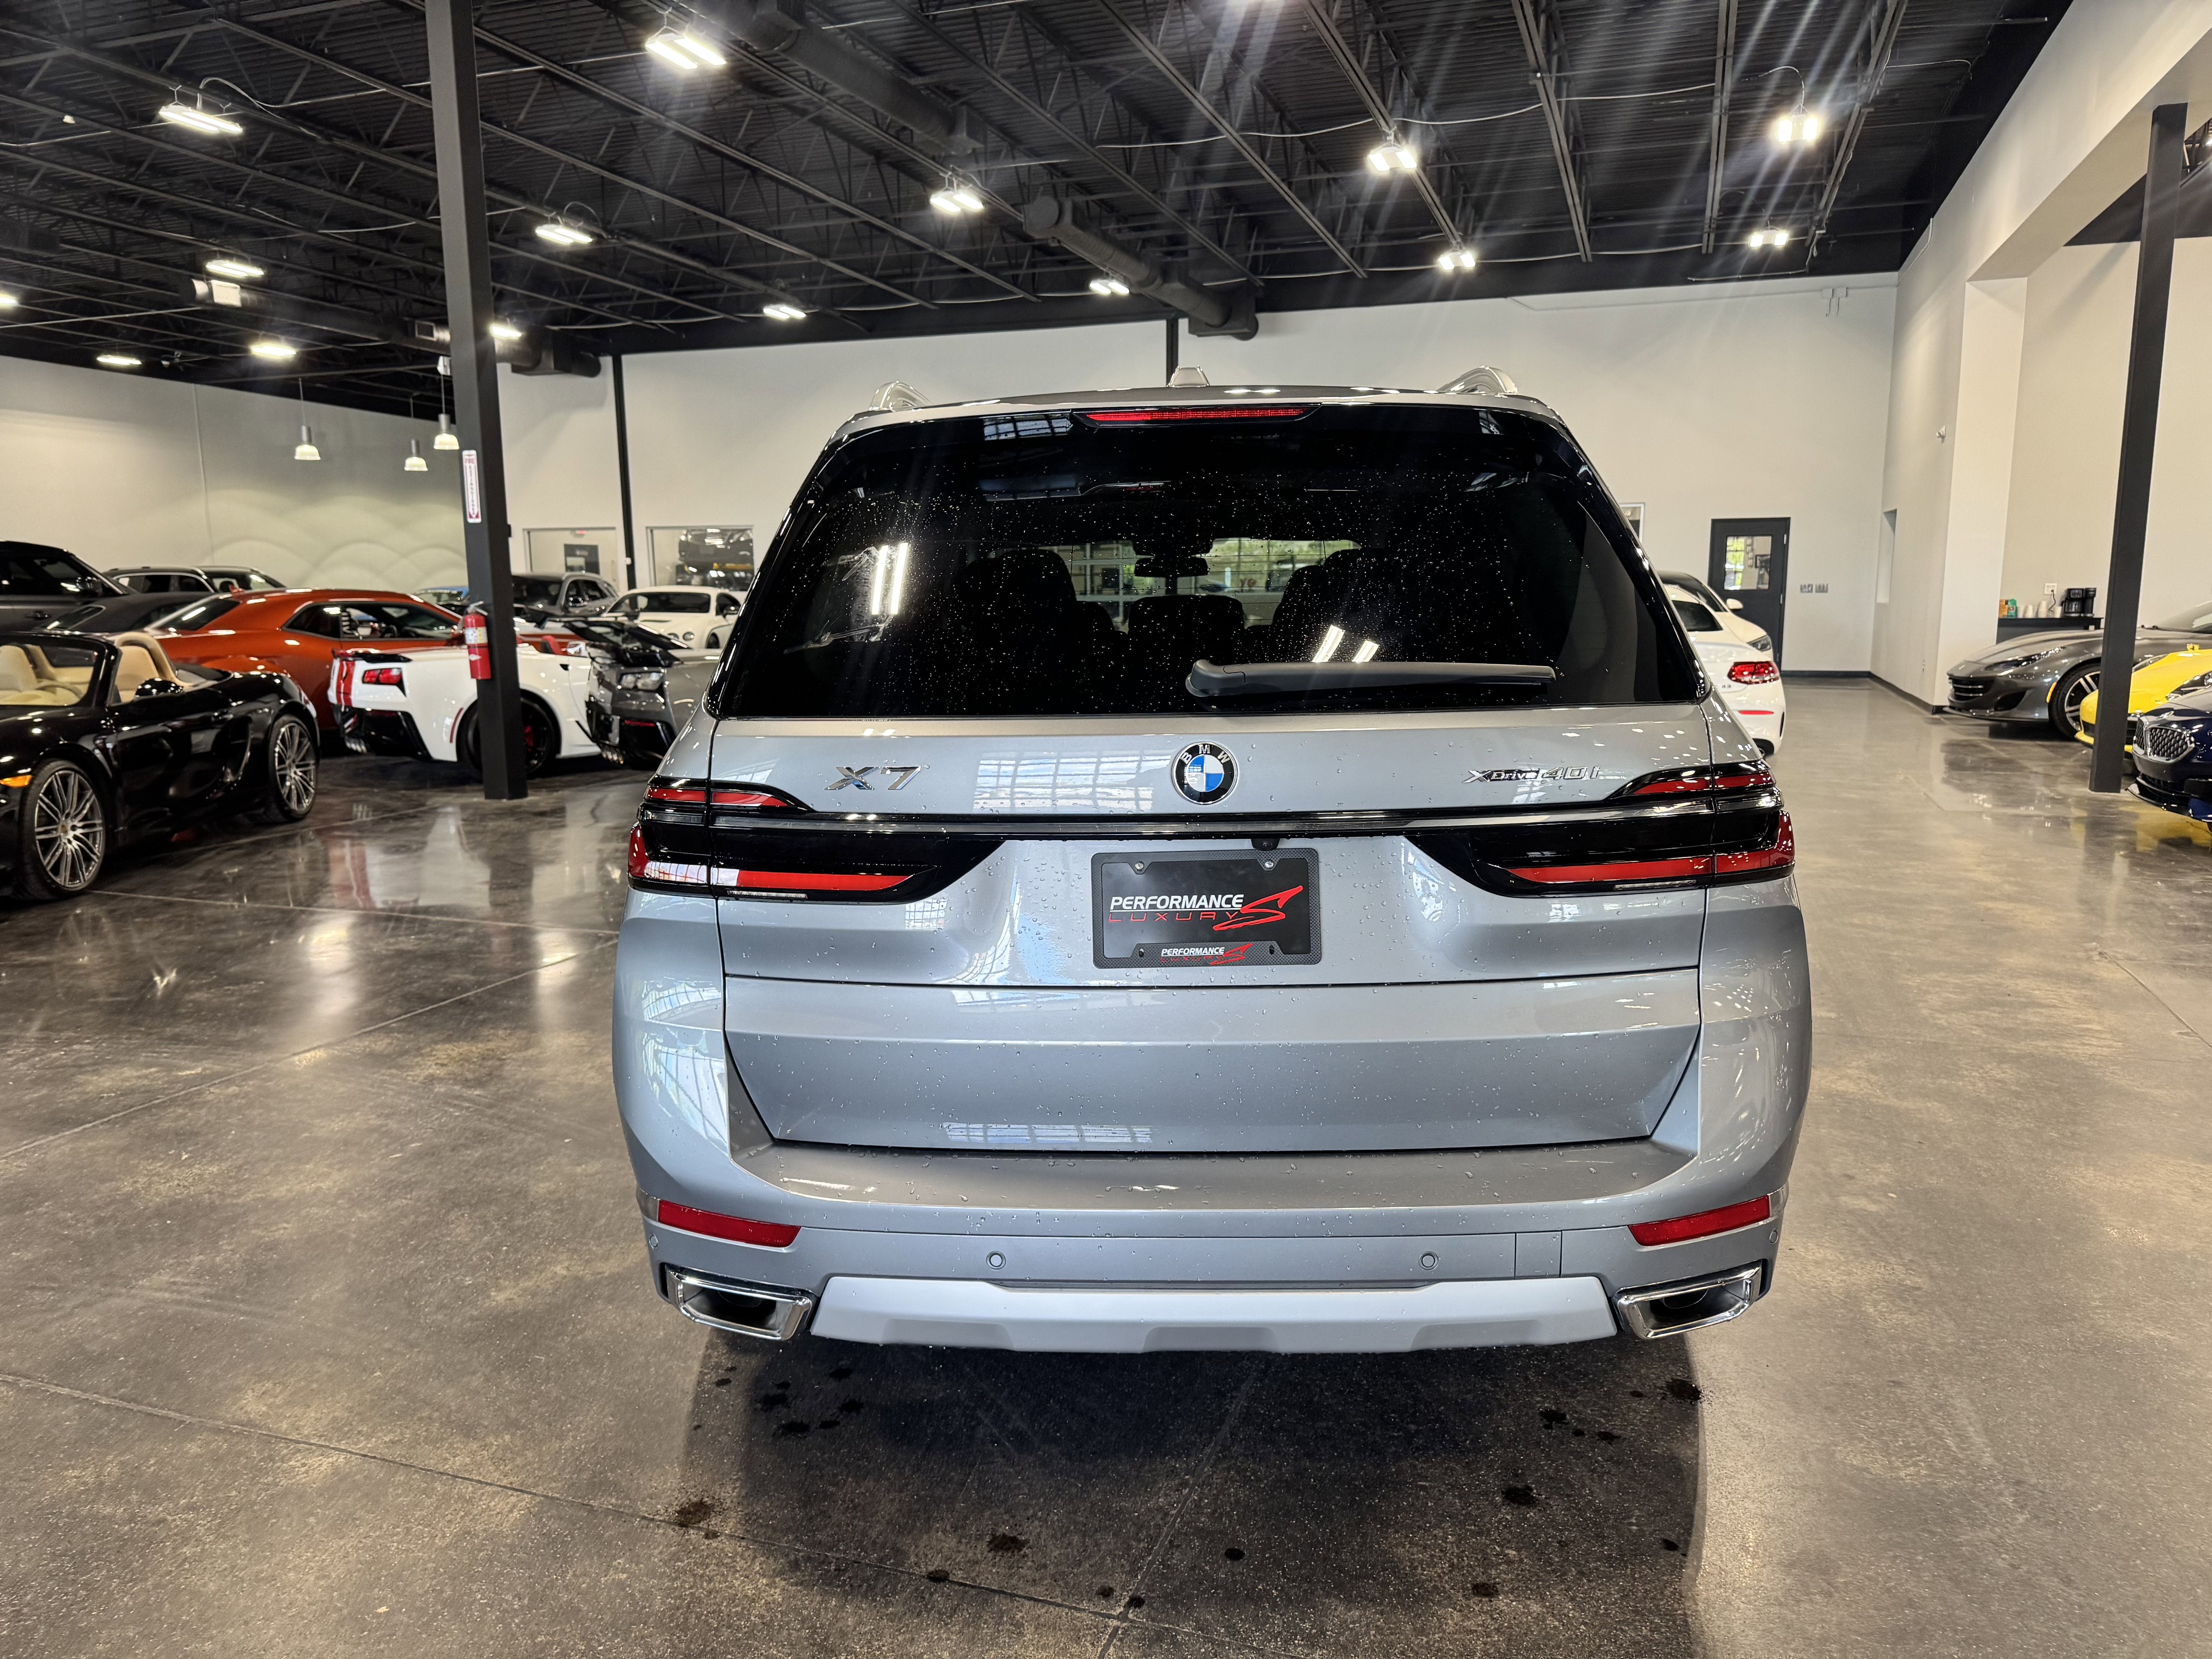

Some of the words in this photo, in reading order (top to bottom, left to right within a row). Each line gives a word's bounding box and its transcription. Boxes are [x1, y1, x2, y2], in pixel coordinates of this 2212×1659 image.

[1180, 744, 1230, 764] BMW
[824, 765, 922, 790] X7
[1109, 895, 1244, 910] PERFORMANCE
[1108, 911, 1238, 922] LUXURY
[1161, 947, 1225, 956] PERFORMANCE
